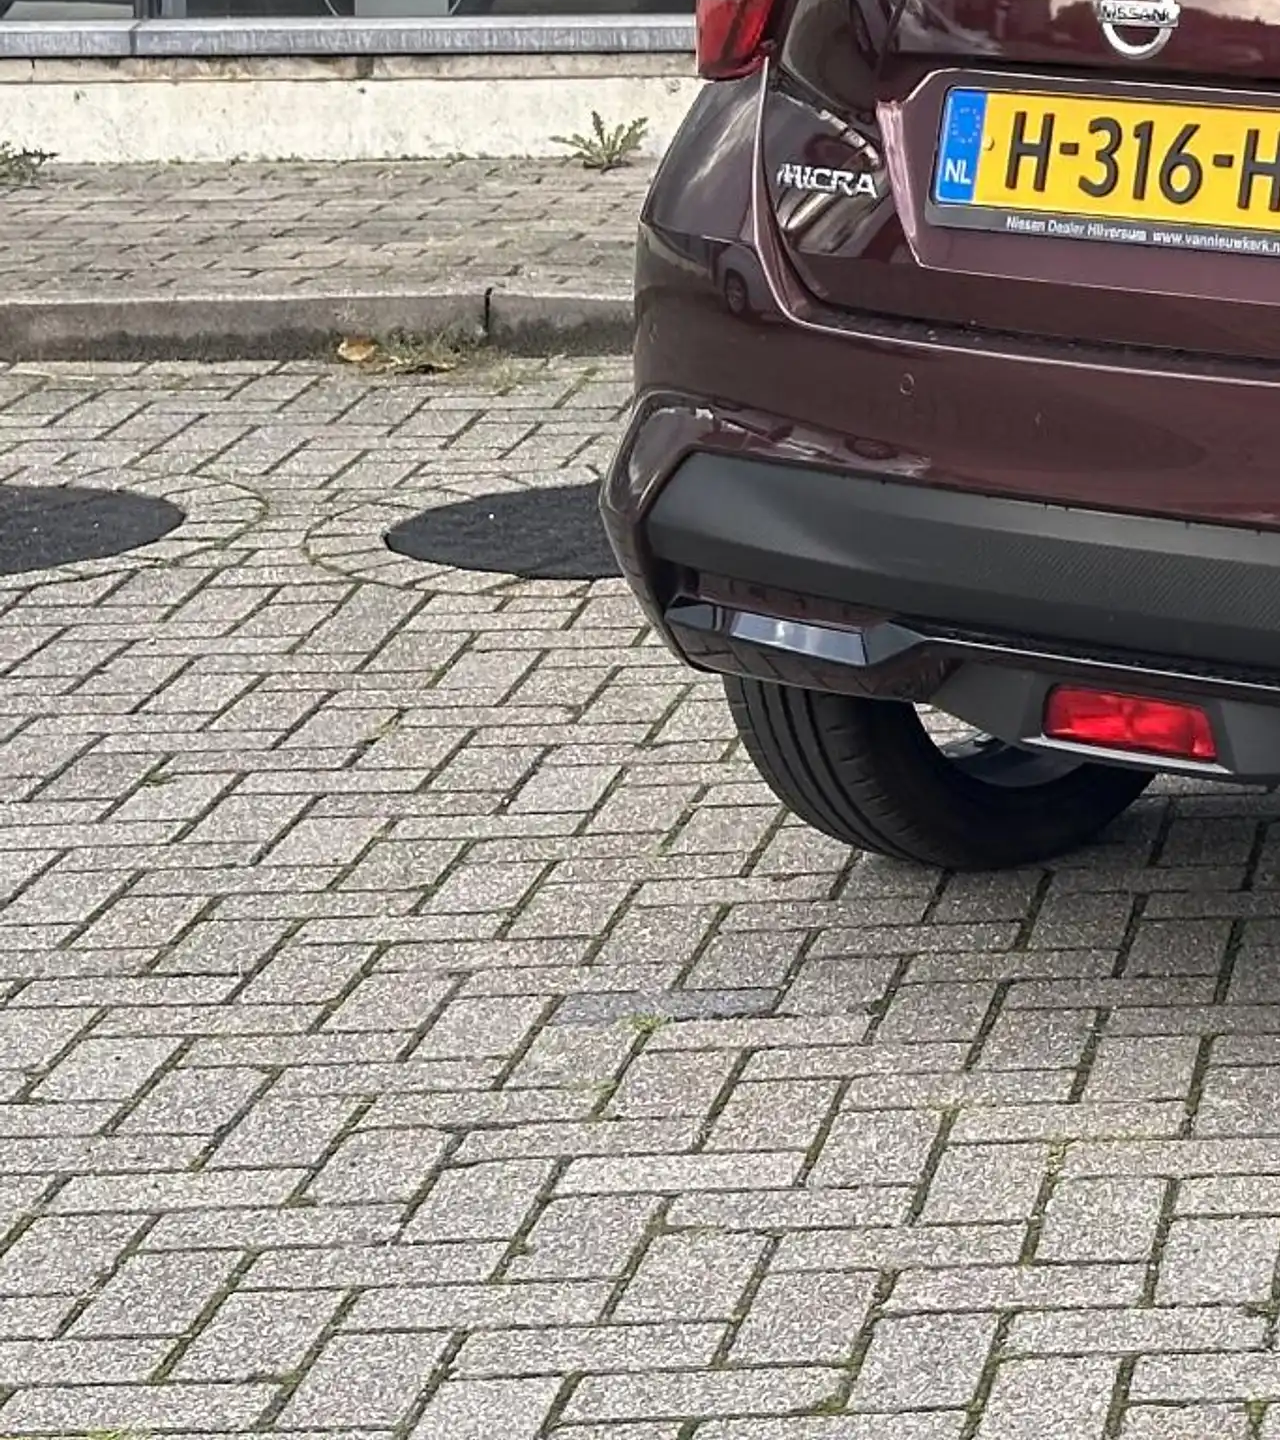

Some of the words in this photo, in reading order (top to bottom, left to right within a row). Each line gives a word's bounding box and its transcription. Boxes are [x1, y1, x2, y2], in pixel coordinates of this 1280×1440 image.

[1101, 4, 1170, 22] NISSAN
[776, 163, 878, 199] MICRA
[943, 158, 971, 185] NL
[1006, 215, 1046, 233] Nissan
[1047, 219, 1085, 236] Dealer
[1087, 222, 1147, 242] Hilversum
